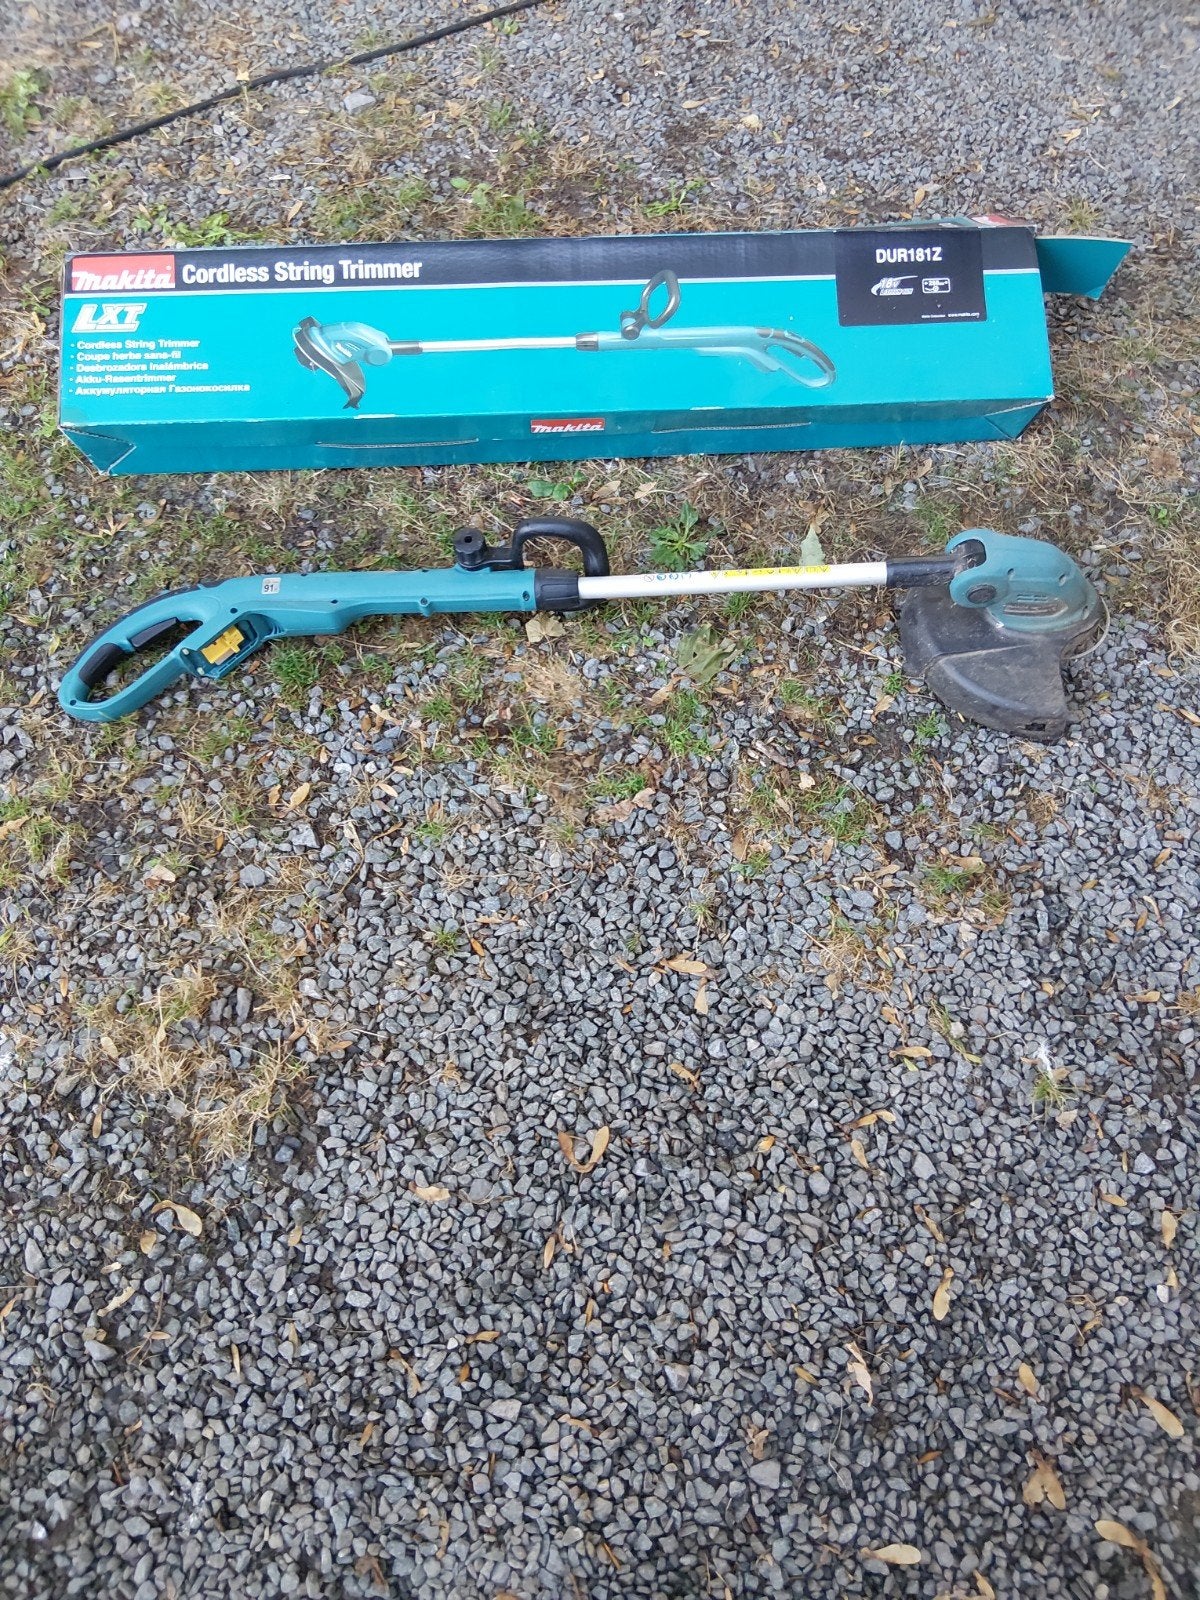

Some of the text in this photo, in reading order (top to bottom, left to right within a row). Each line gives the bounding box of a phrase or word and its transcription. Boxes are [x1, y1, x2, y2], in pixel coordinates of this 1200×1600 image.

[875, 247, 943, 264] DUR181Z
[182, 259, 423, 284] Cordless String Trimmer
[71, 303, 148, 334] LXT
[76, 338, 201, 351] Cordless String Trimmer
[76, 350, 182, 362] Coupe herbe sans-fil
[264, 584, 274, 593] 91
